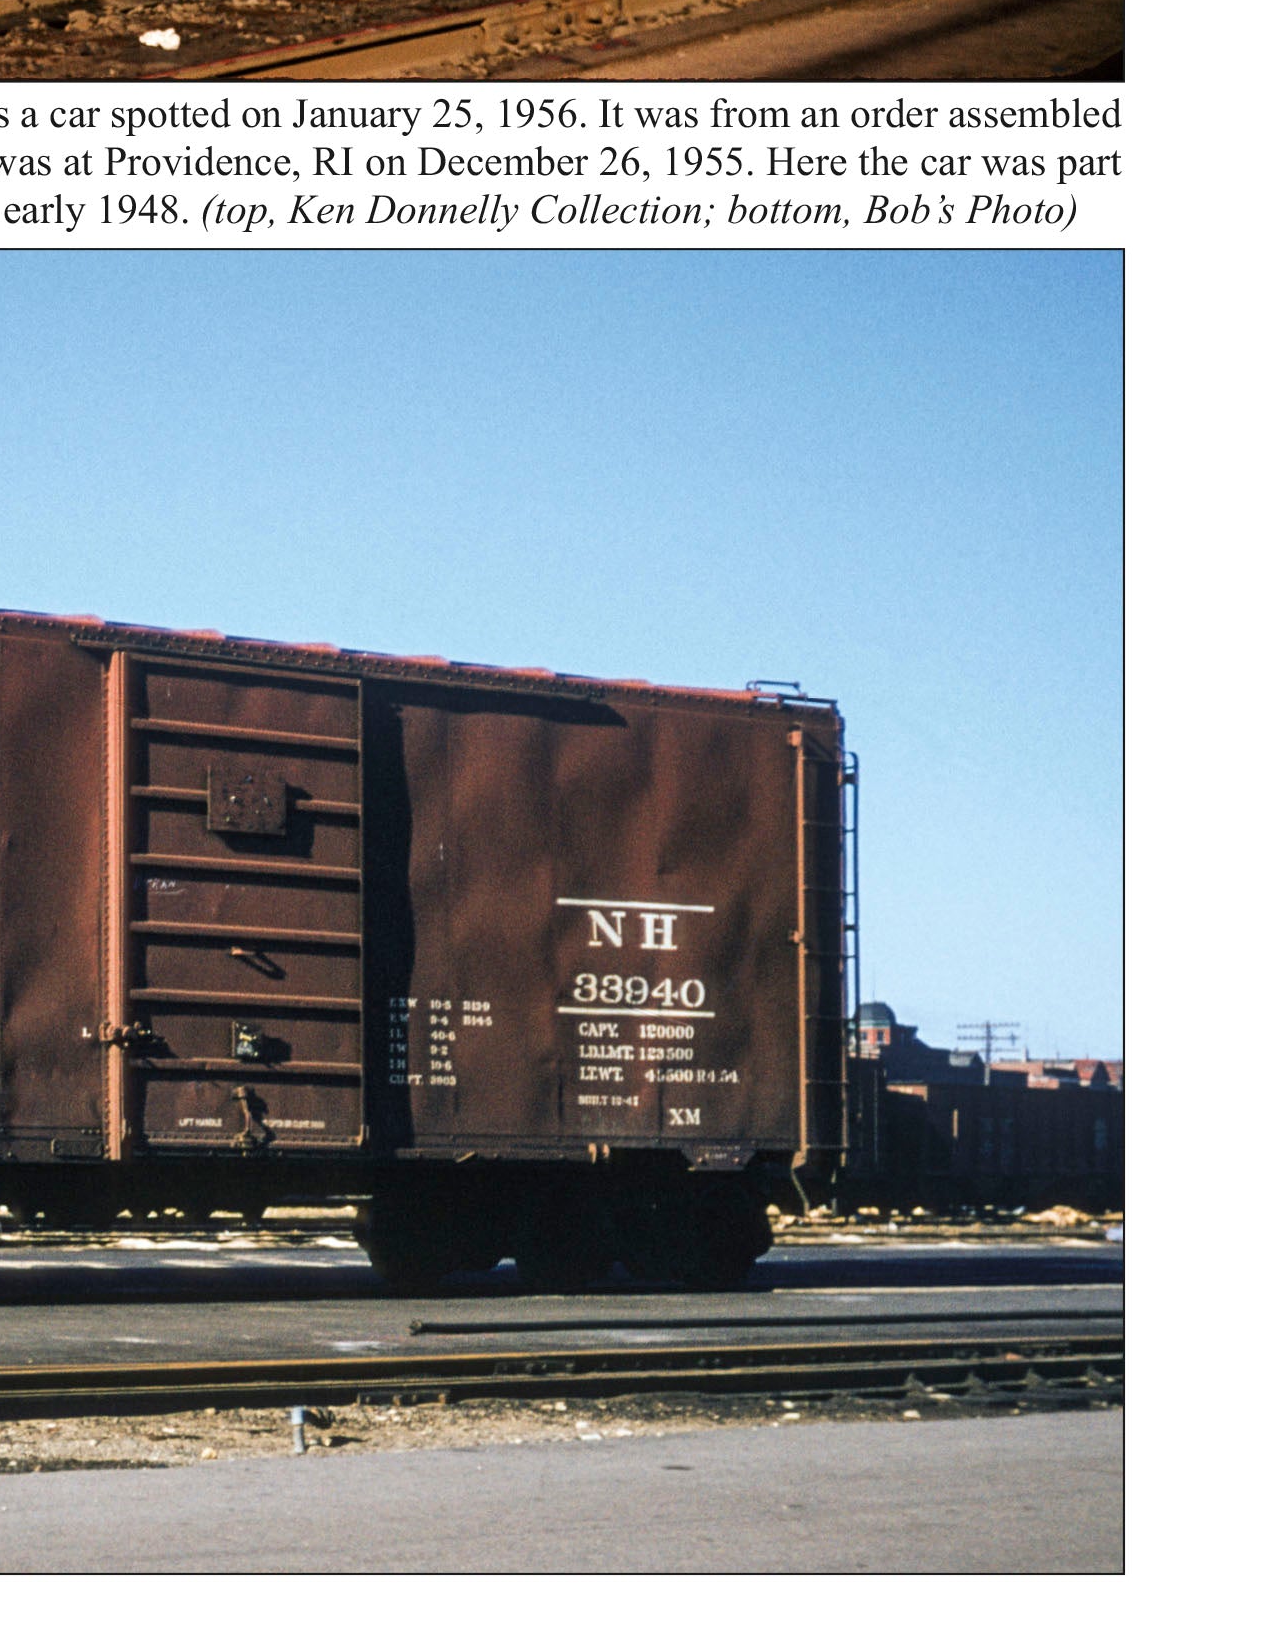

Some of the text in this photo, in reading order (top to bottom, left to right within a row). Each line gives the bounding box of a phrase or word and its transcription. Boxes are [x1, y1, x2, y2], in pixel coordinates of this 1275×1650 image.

[574, 973, 706, 1008] 33940
[578, 1022, 694, 1039] CAPY. 120000
[639, 1047, 693, 1061] 123500
[669, 1108, 701, 1126] XM
